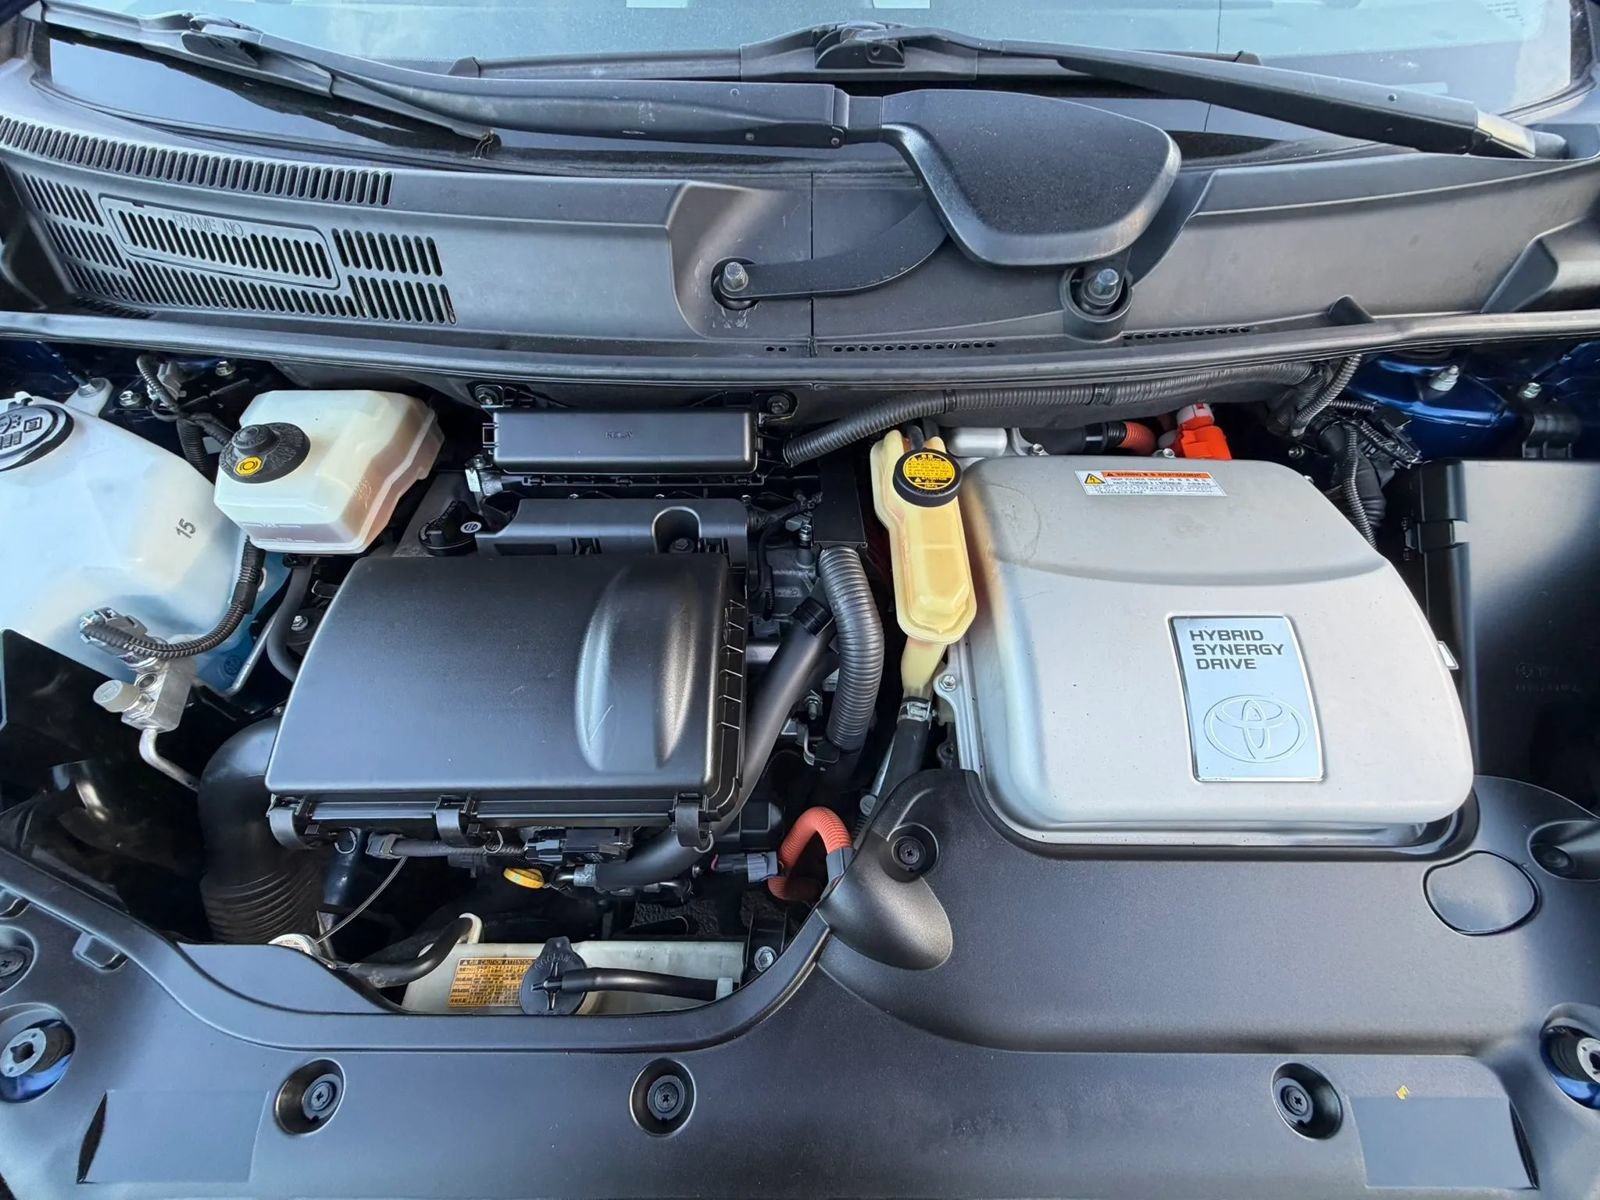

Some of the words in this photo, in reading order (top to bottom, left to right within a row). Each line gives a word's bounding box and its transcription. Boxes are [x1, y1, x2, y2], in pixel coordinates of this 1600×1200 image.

[172, 212, 219, 234] FRAME
[176, 517, 196, 539] 15
[1189, 629, 1264, 641] HYBRID
[1192, 643, 1284, 656] SYNERGY
[1196, 658, 1257, 670] DRIVE
